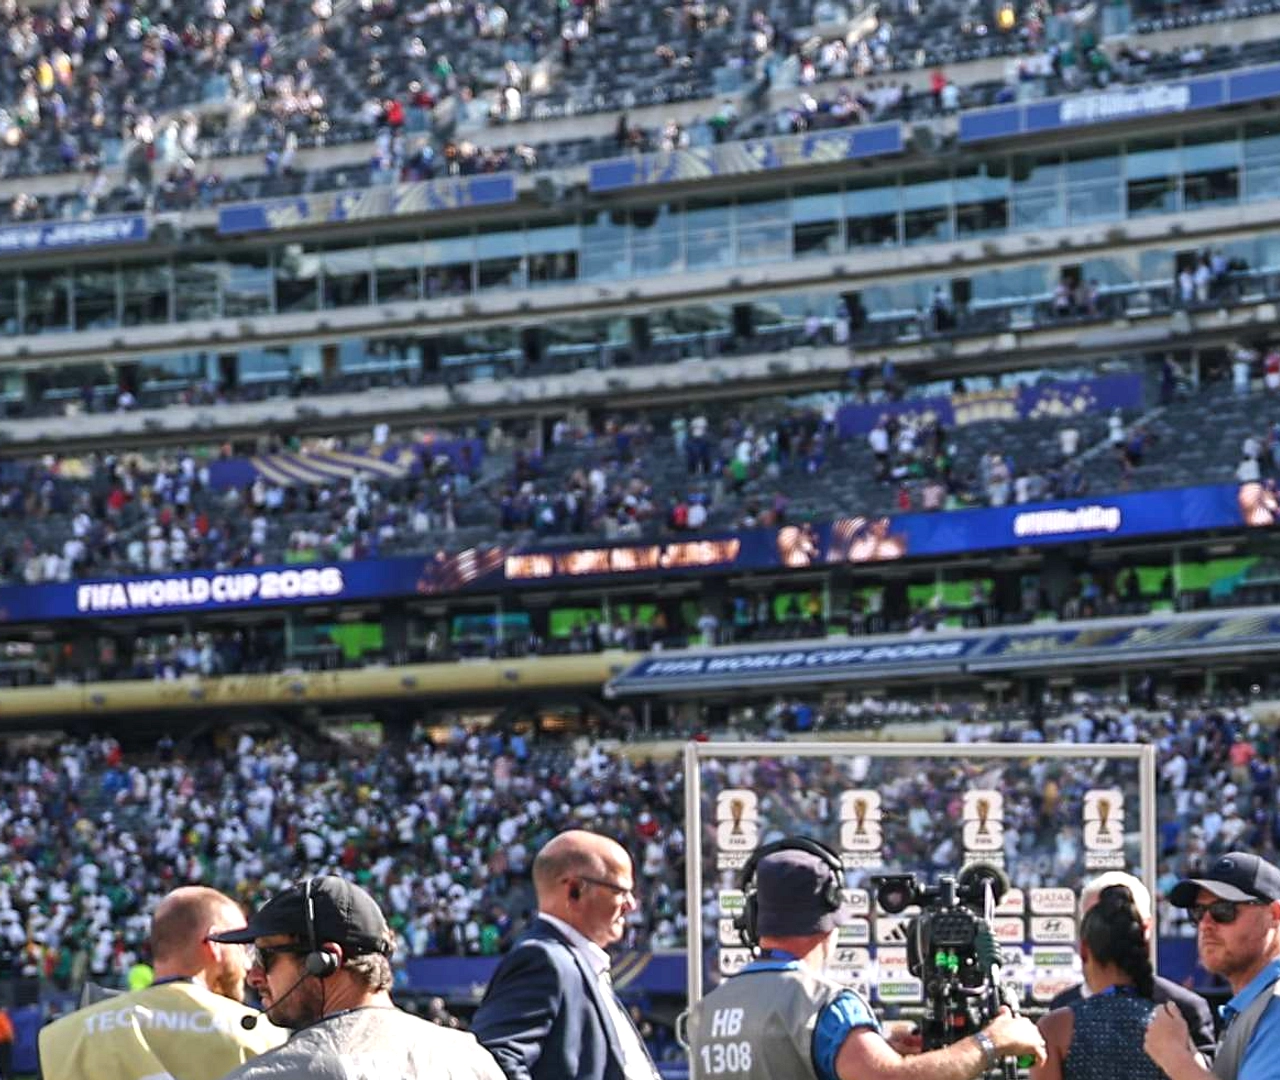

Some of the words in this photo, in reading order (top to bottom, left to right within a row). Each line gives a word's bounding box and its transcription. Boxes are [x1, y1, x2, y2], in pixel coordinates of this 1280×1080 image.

[77, 582, 129, 612] FIFA
[128, 576, 211, 608] WORLD
[211, 573, 259, 602] CUP
[259, 567, 345, 599] 2026
[711, 1008, 744, 1037] HB
[701, 1041, 752, 1075] 1308
